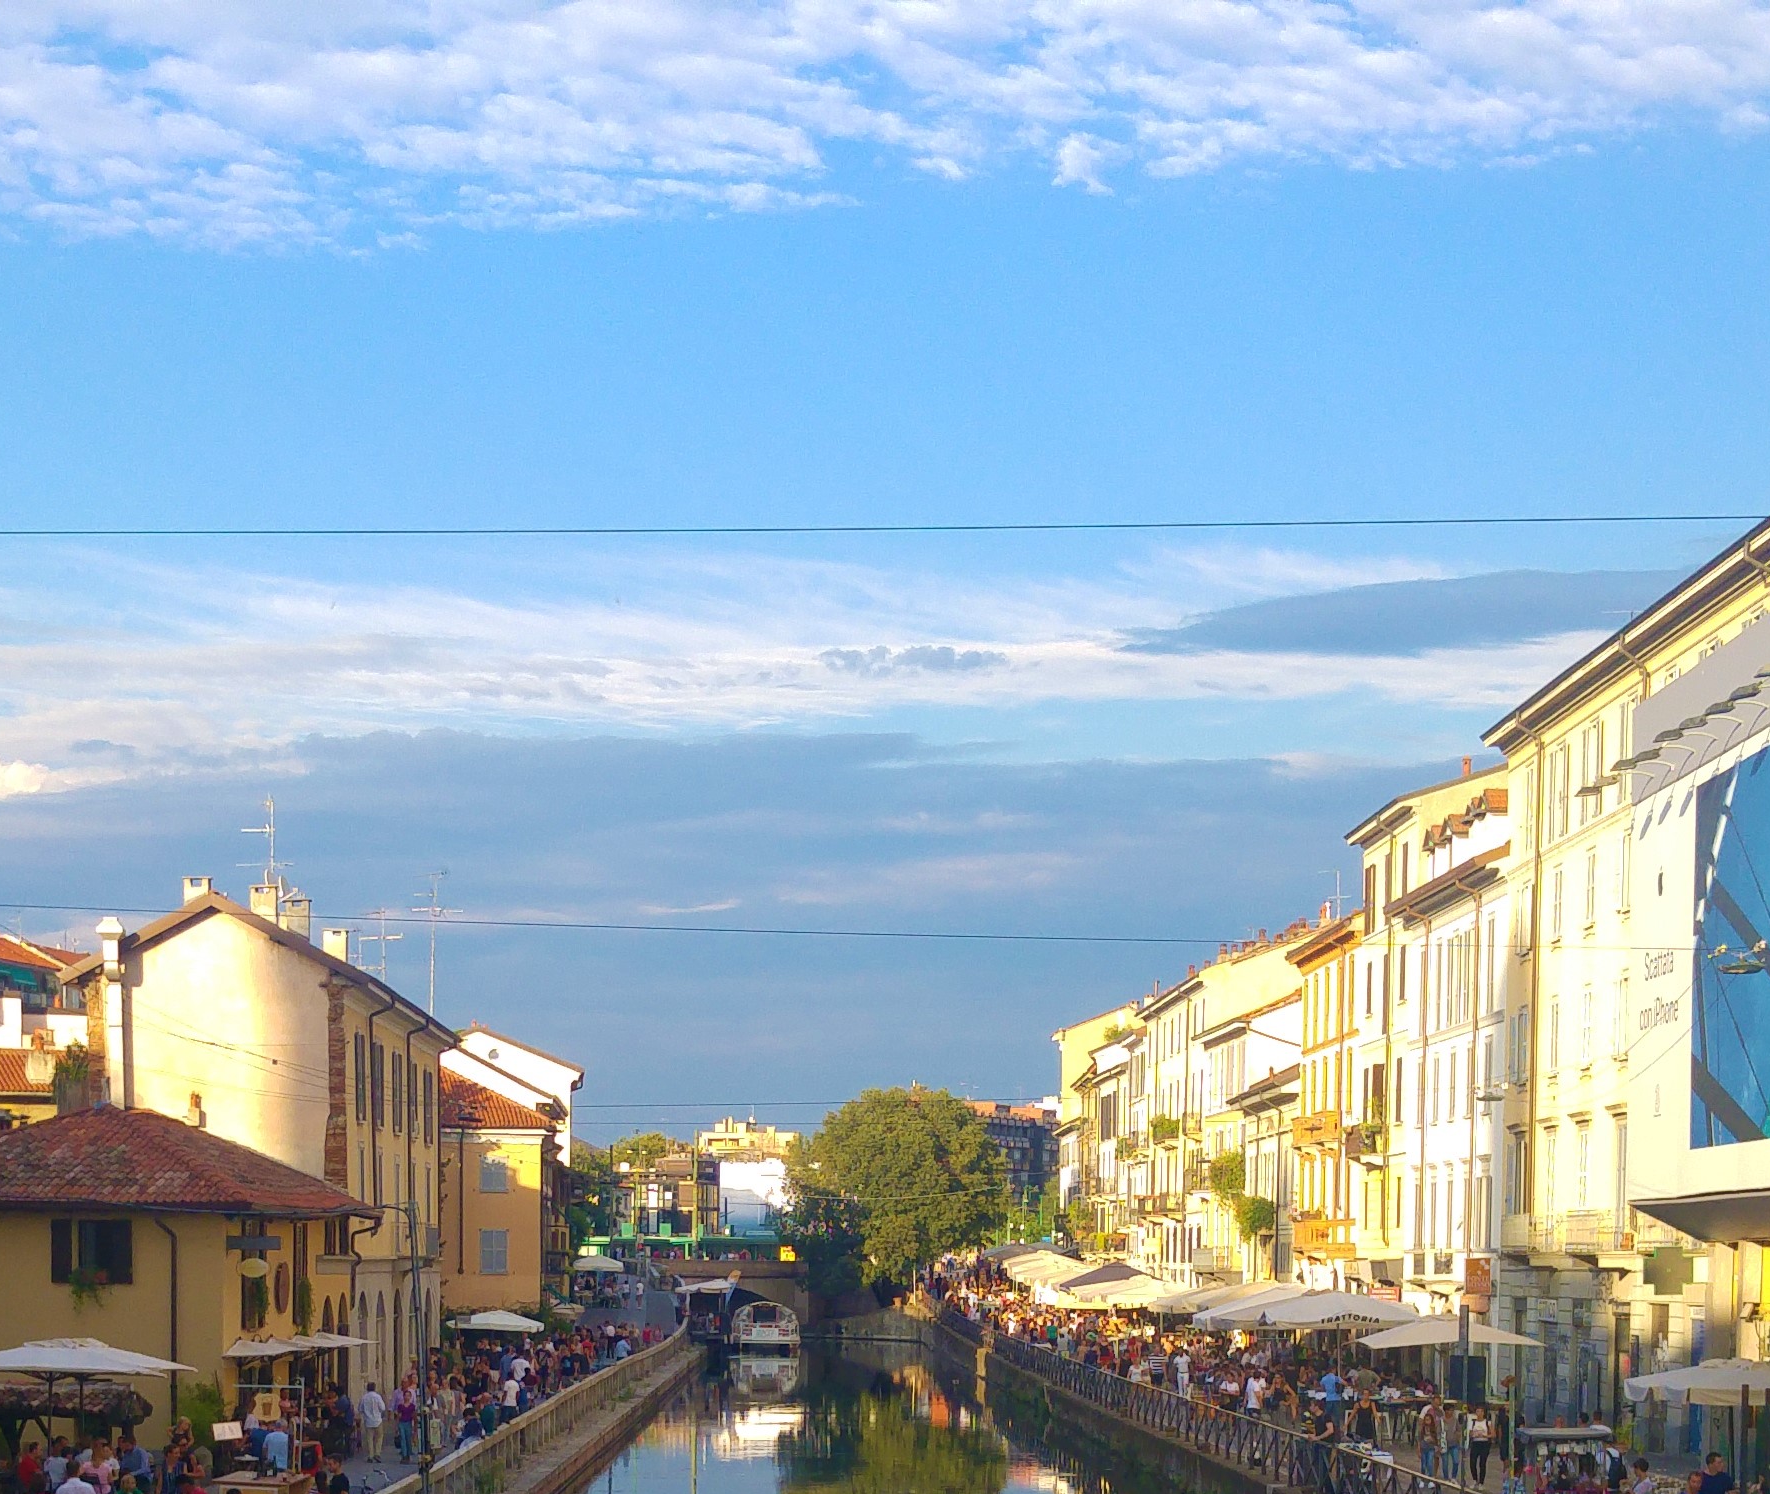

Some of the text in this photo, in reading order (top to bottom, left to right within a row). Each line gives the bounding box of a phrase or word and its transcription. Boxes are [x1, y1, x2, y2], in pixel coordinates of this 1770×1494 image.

[1644, 951, 1674, 981] Scattata
[1653, 996, 1679, 1027] iPhone
[1321, 1313, 1380, 1324] TRATTORIA
